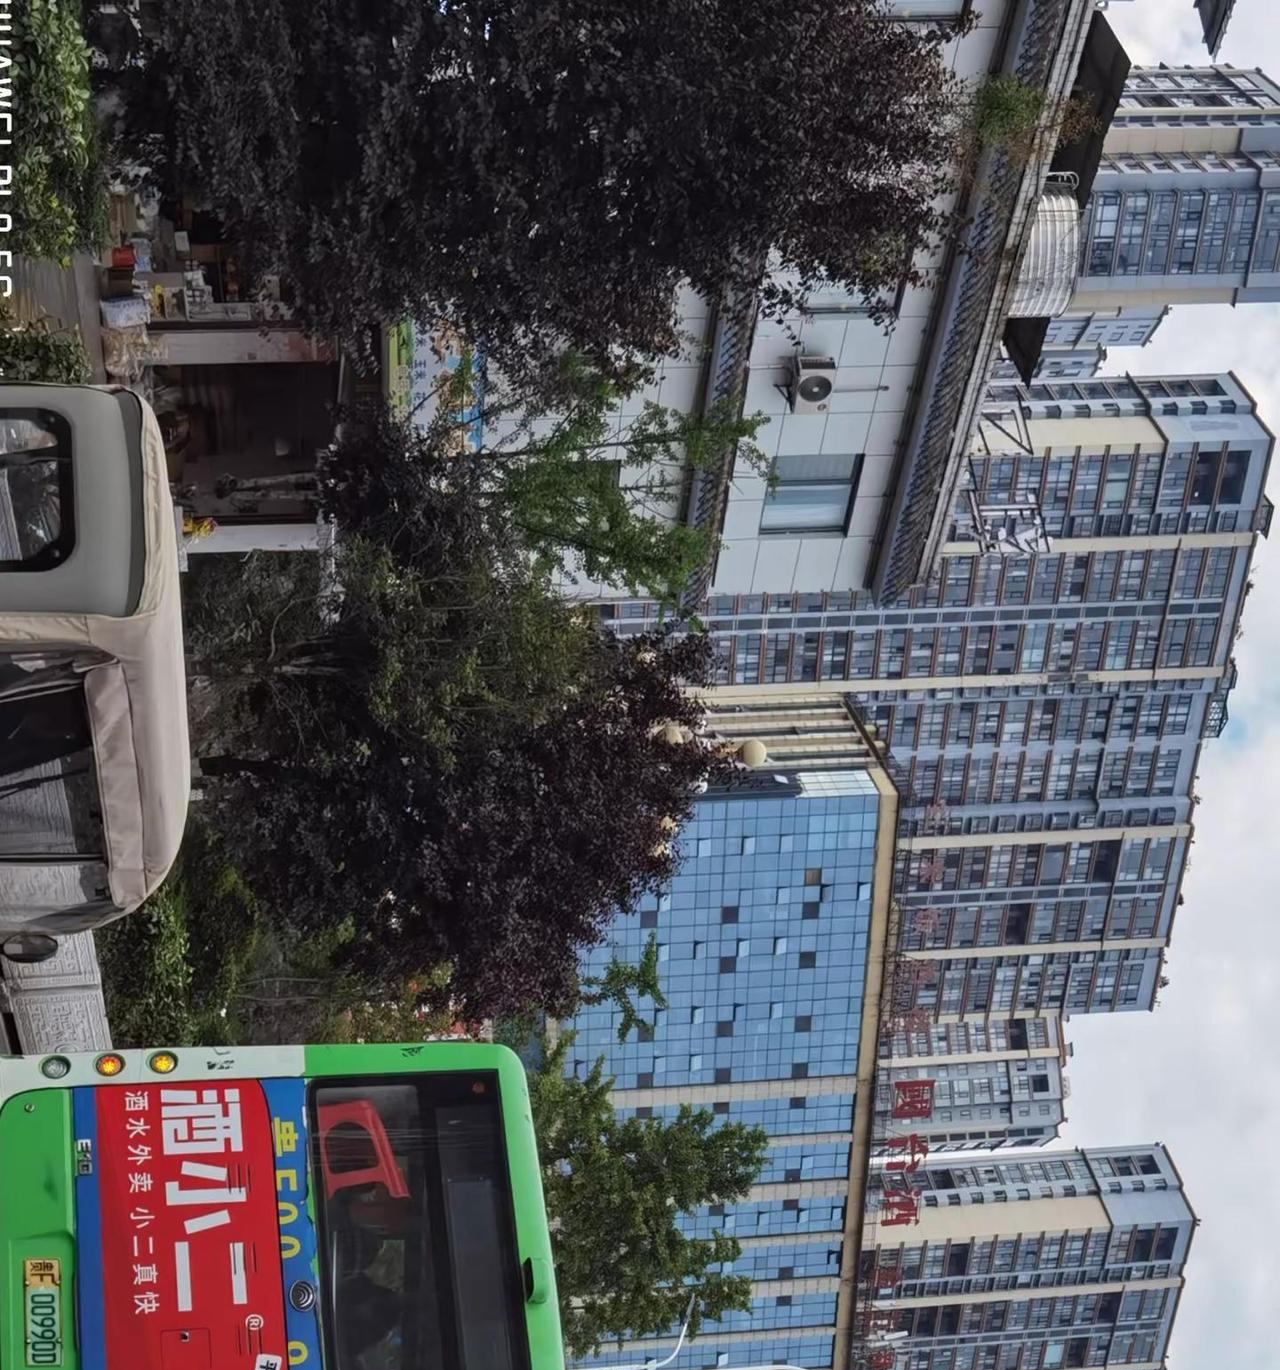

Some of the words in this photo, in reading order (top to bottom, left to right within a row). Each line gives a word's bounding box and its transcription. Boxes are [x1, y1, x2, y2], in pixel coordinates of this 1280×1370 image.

[124, 1091, 152, 1194] 酒水外卖
[159, 1088, 248, 1312] 酒小二
[131, 1206, 159, 1316] 小二真快
